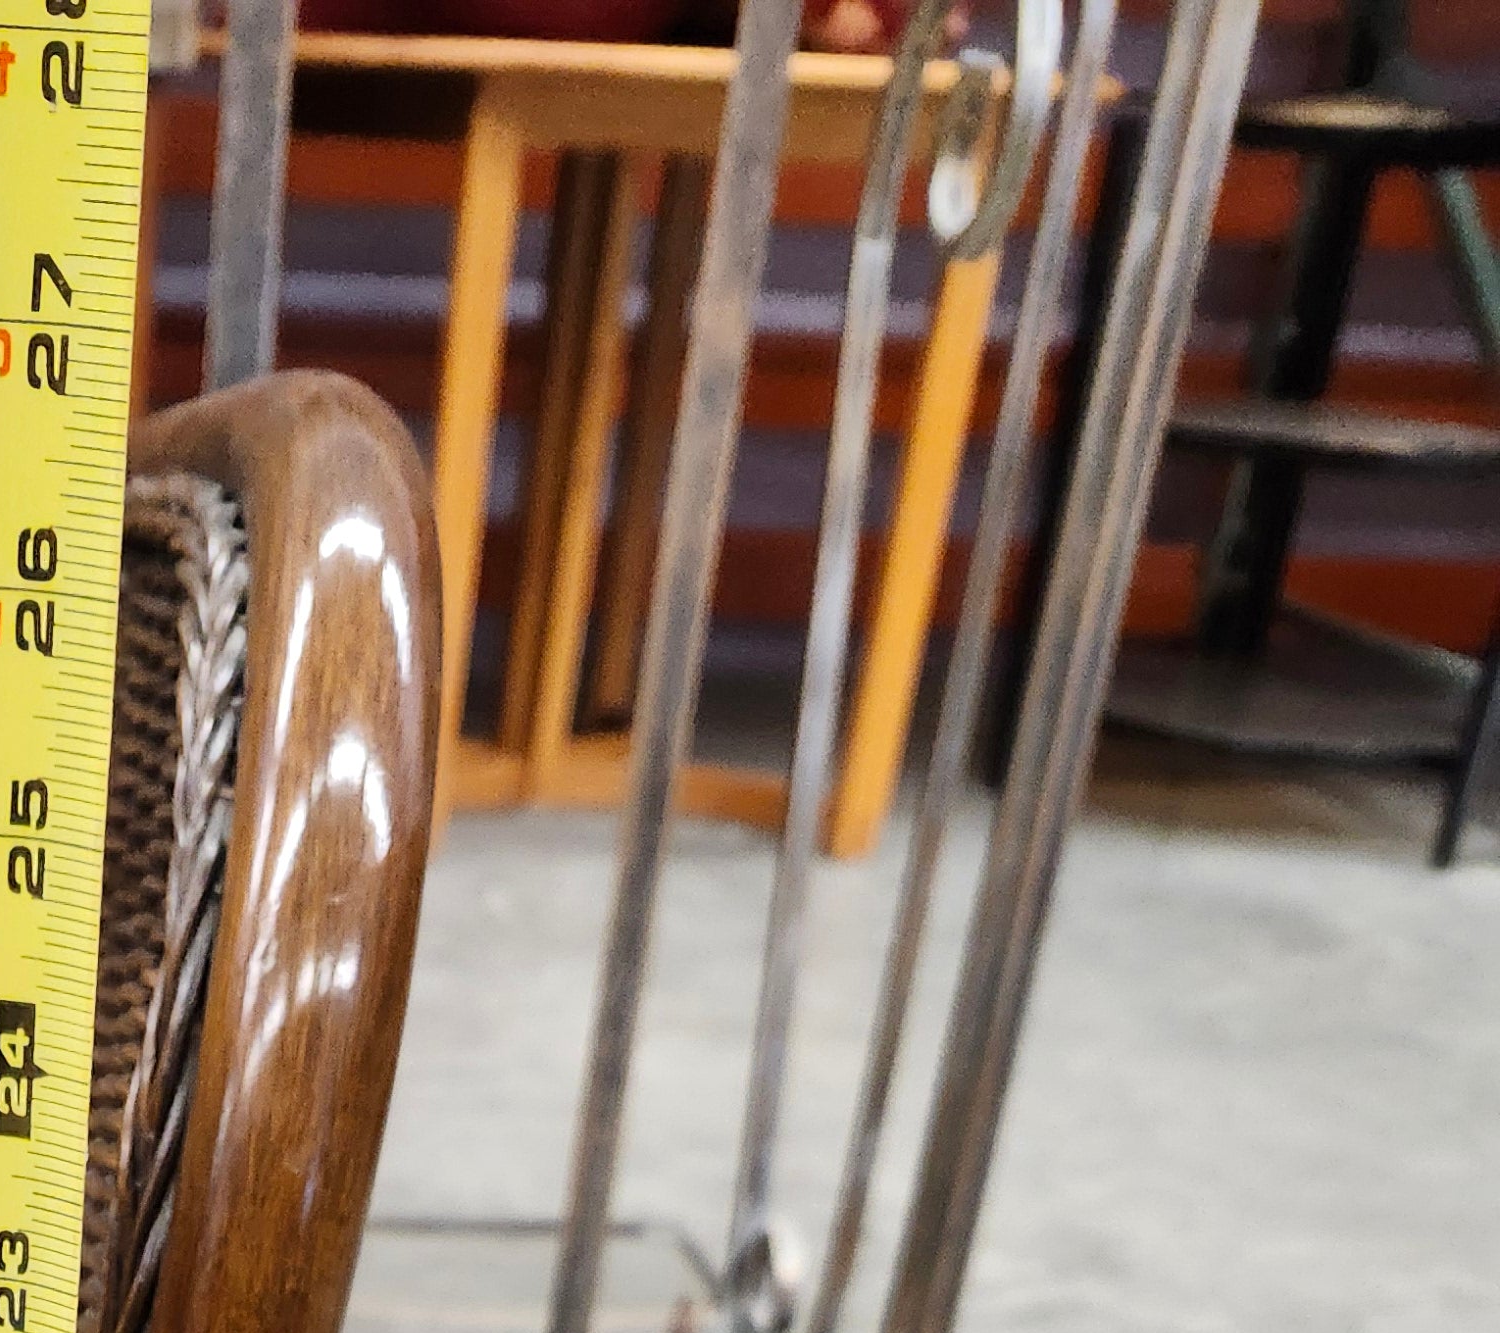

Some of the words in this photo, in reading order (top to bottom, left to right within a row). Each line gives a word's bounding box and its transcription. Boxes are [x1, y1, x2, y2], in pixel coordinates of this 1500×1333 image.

[26, 252, 73, 396] 27
[14, 526, 58, 657] 26
[7, 778, 49, 900] 25
